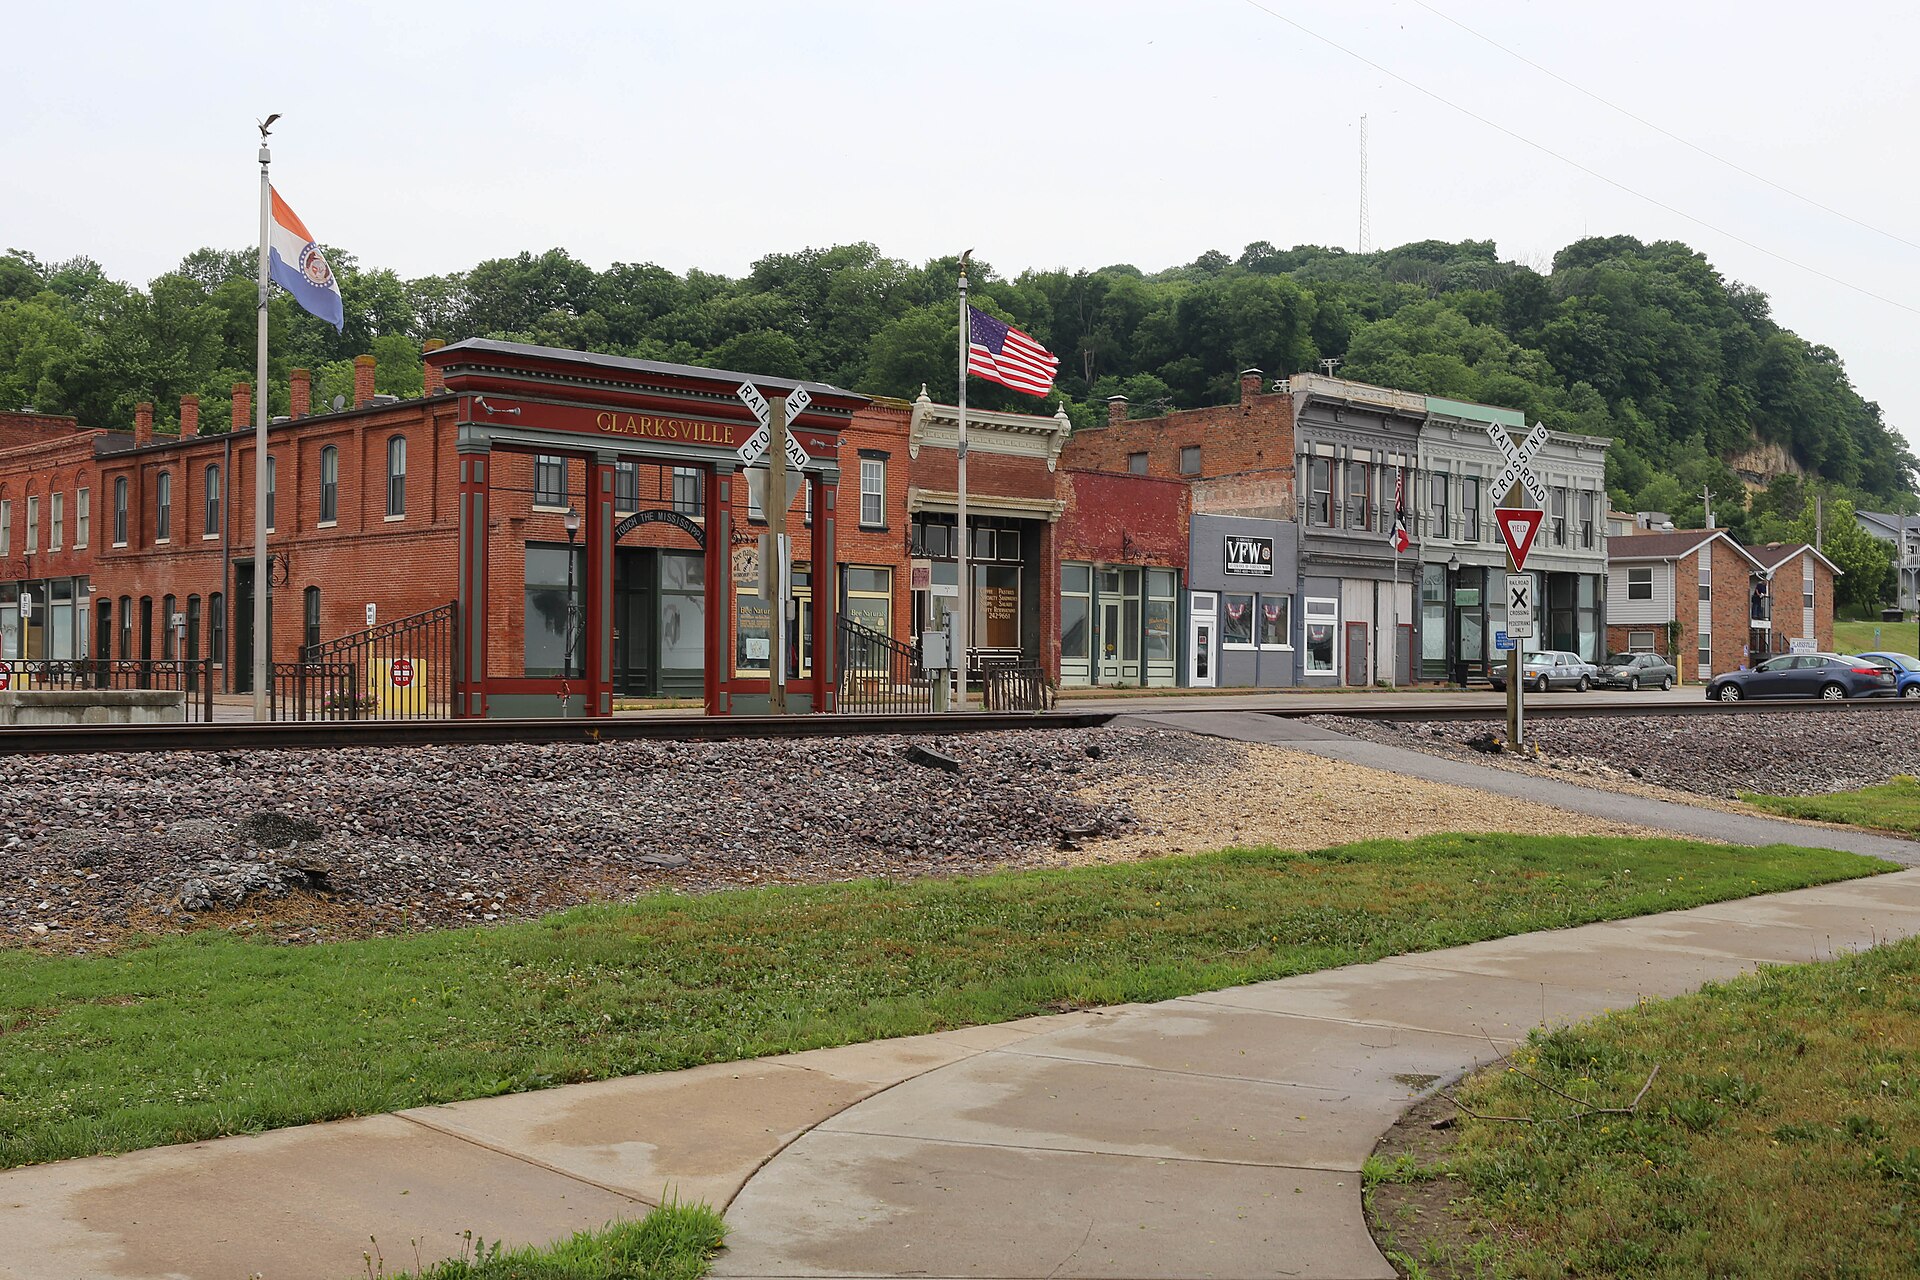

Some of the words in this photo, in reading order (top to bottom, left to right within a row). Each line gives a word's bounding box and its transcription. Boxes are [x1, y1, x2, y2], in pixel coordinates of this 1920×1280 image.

[596, 412, 735, 444] CLARKSVILLE
[1491, 427, 1546, 500] CROSSING
[615, 516, 638, 537] TOUCH
[640, 511, 655, 521] THE
[1511, 524, 1527, 533] YIELD
[1227, 540, 1262, 564] VFW
